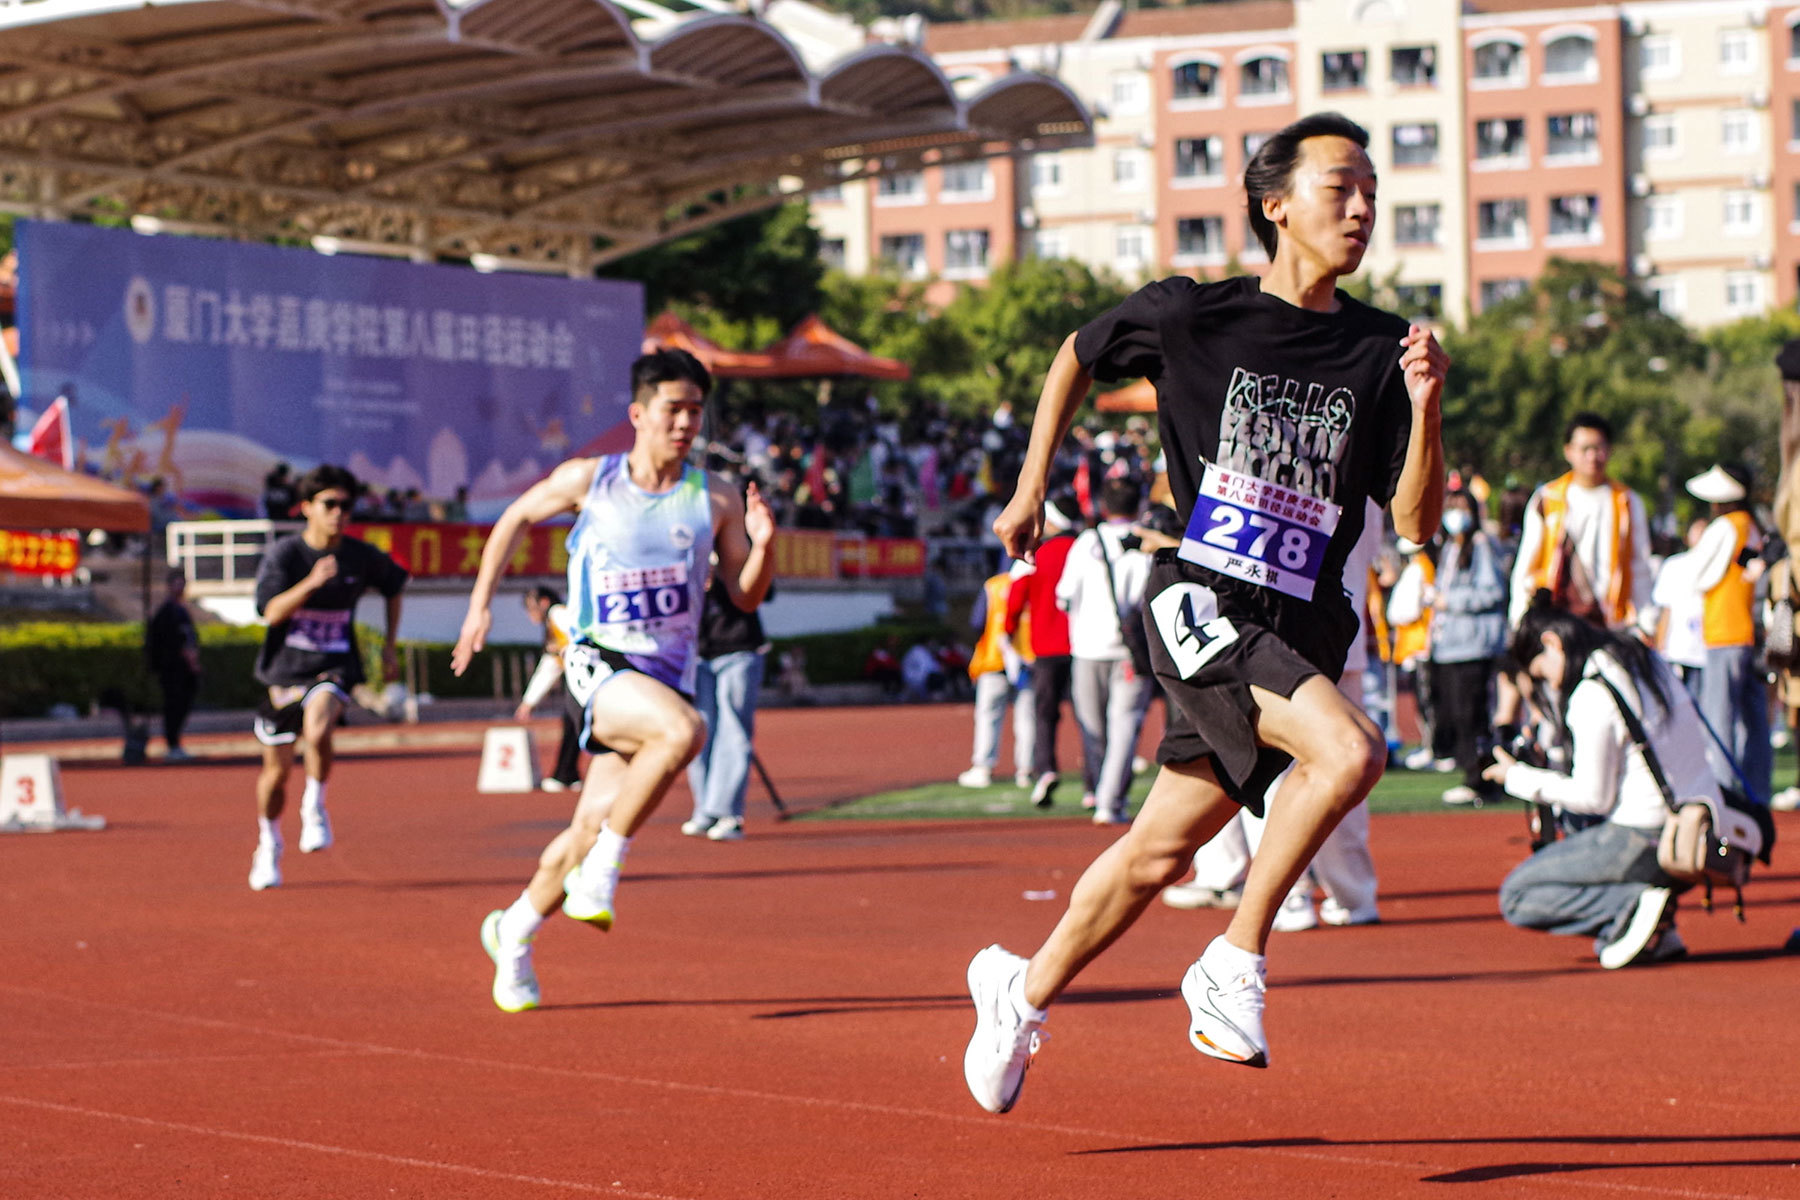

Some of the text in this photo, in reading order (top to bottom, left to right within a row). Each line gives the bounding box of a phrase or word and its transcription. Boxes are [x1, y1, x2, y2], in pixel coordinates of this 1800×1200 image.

[1226, 367, 1356, 430] HELLO
[1216, 485, 1321, 527] 第八届田径运动会
[1218, 472, 1327, 516] 厦门大学嘉庚学院
[1202, 504, 1311, 570] 278
[605, 588, 680, 622] 210
[1174, 592, 1219, 655] 4
[498, 744, 515, 770] 2
[17, 776, 36, 805] 3
